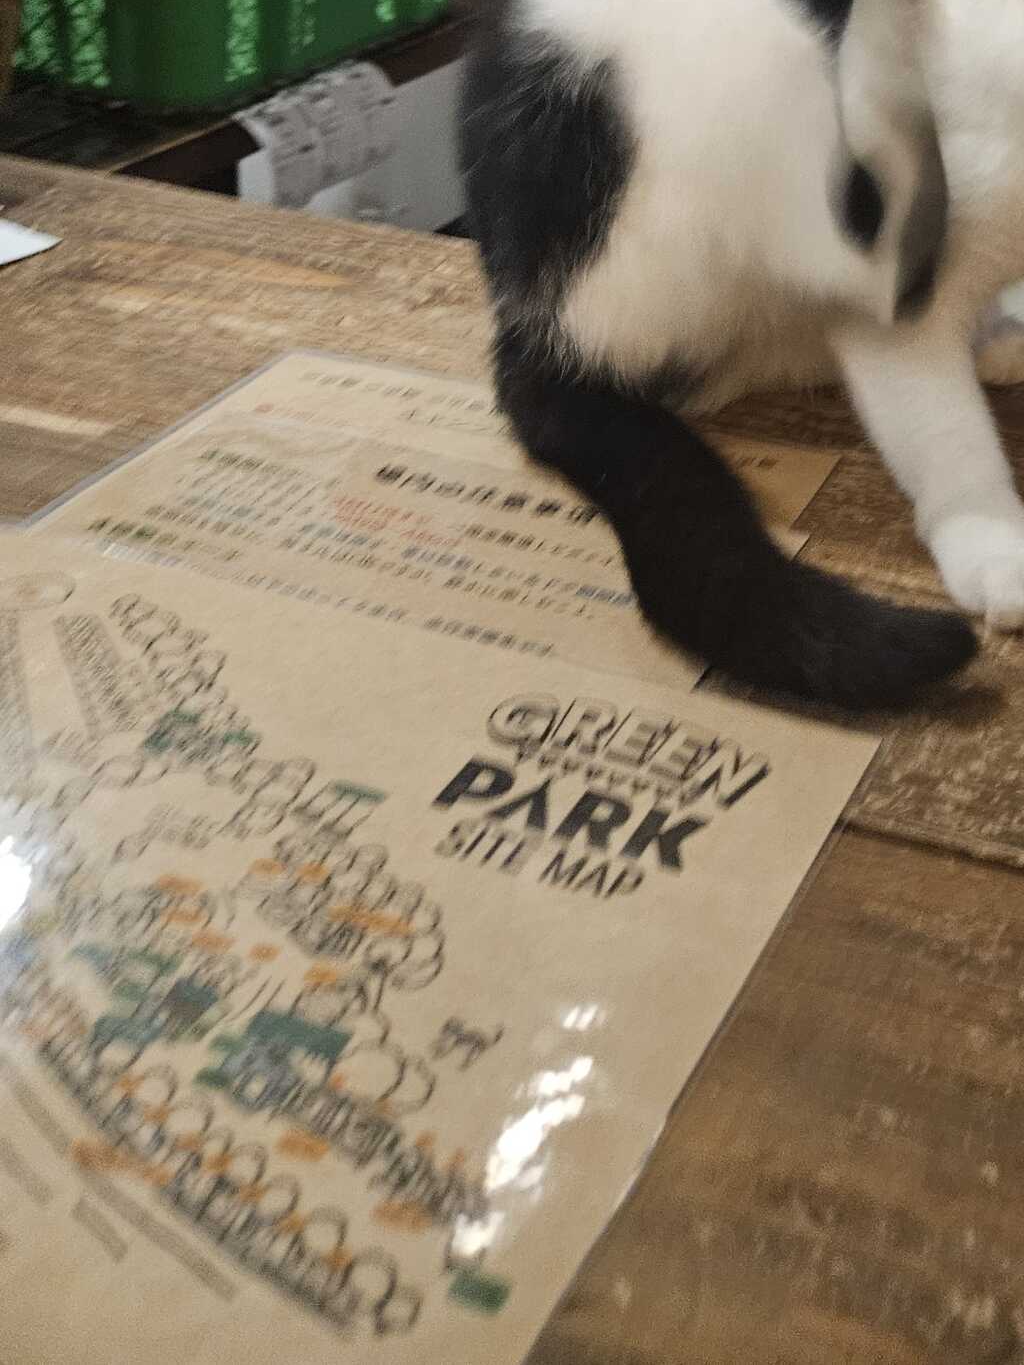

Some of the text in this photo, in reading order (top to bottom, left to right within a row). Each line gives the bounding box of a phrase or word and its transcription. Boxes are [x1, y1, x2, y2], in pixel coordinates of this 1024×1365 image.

[486, 694, 774, 809] GREEN
[430, 755, 713, 875] PARK
[434, 816, 647, 899] SITE MAP
